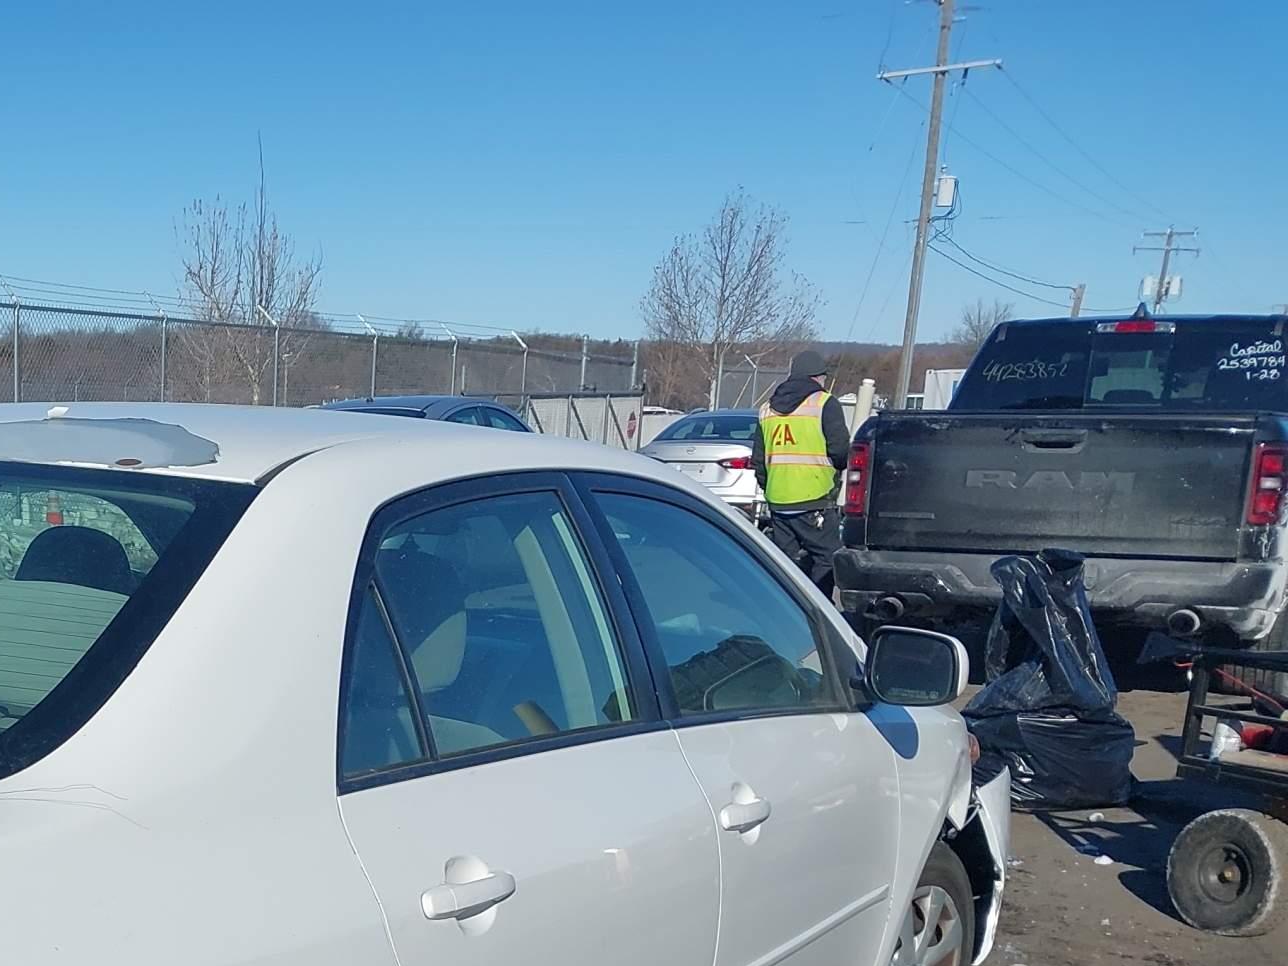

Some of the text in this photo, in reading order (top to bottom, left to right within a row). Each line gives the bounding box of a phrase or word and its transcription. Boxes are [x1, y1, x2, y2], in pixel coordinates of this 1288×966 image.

[1230, 340, 1283, 357] Capital
[1217, 355, 1286, 370] 2539784
[1246, 368, 1281, 380] 1-28
[965, 470, 1137, 490] RAM
